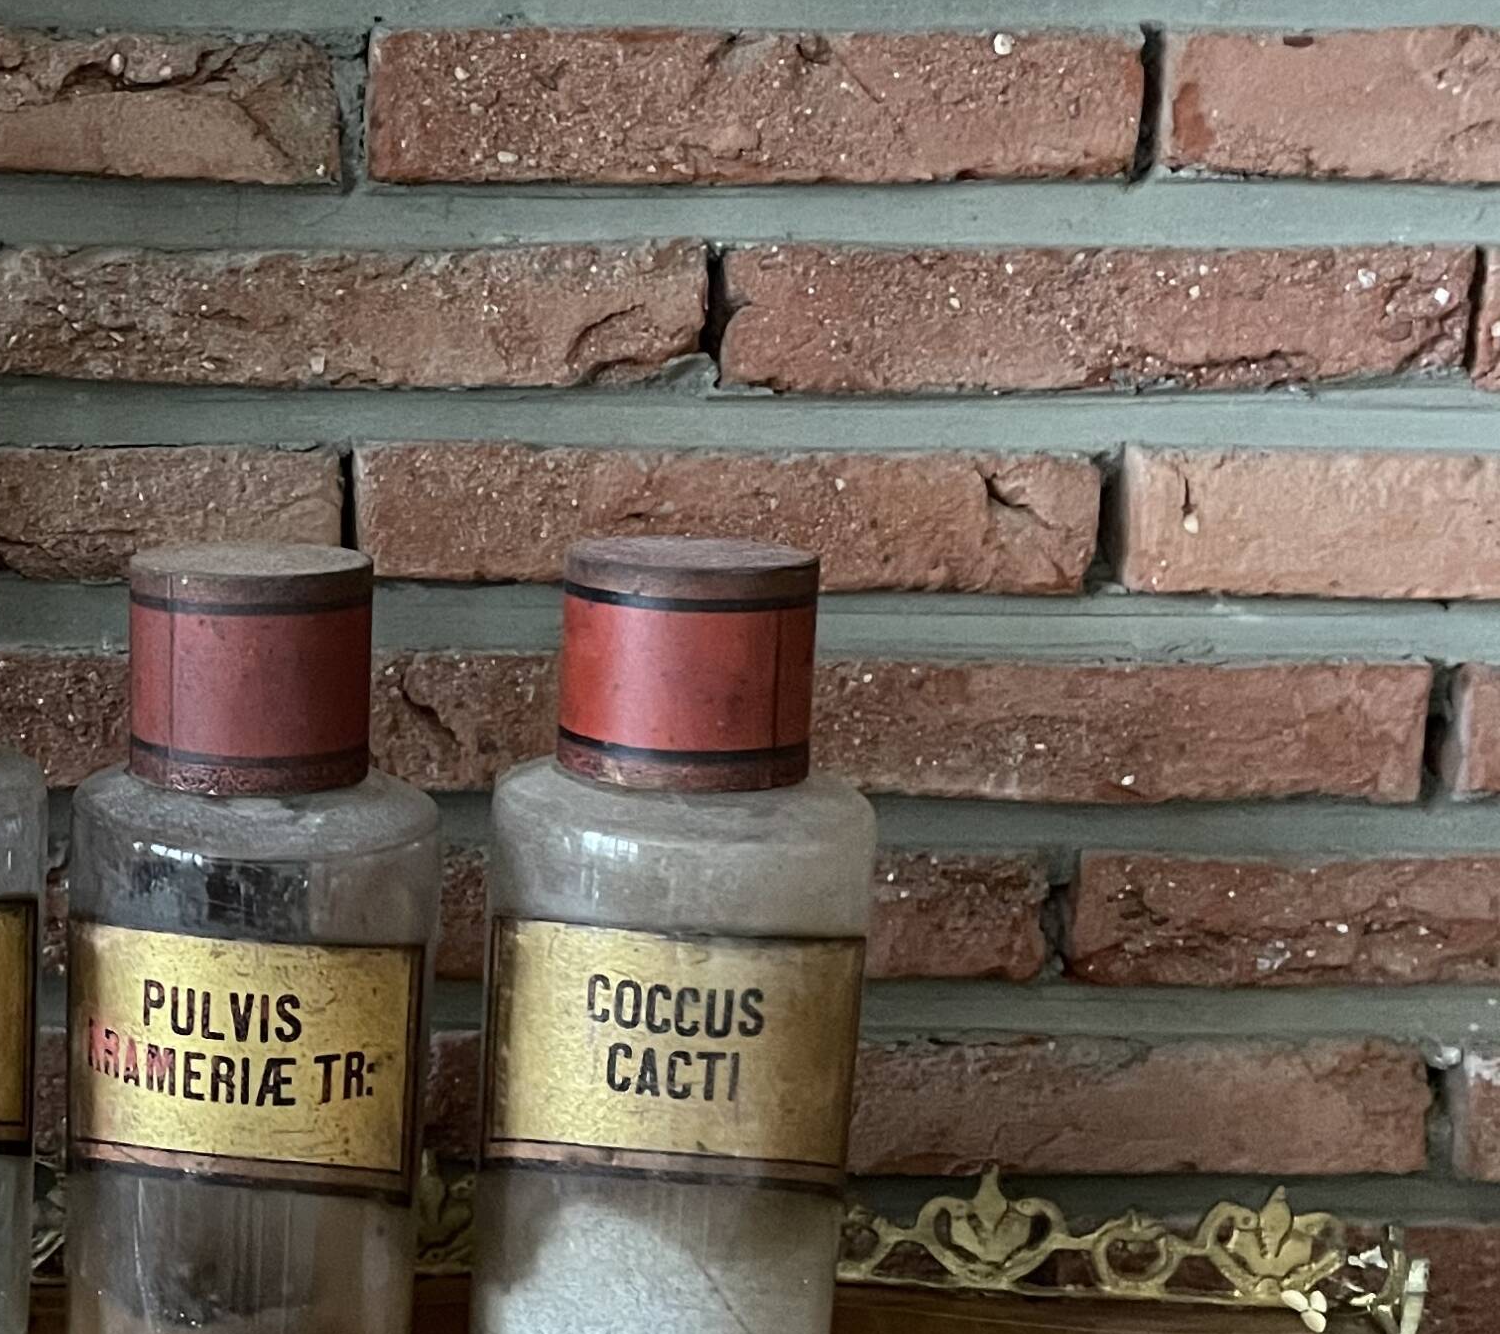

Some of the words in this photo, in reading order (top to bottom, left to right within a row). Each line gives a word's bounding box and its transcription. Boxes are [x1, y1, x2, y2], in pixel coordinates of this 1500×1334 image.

[143, 979, 302, 1043] PULVIS
[587, 974, 764, 1038] COCCUS
[314, 1051, 374, 1105] TR:
[606, 1042, 740, 1101] CACTI
